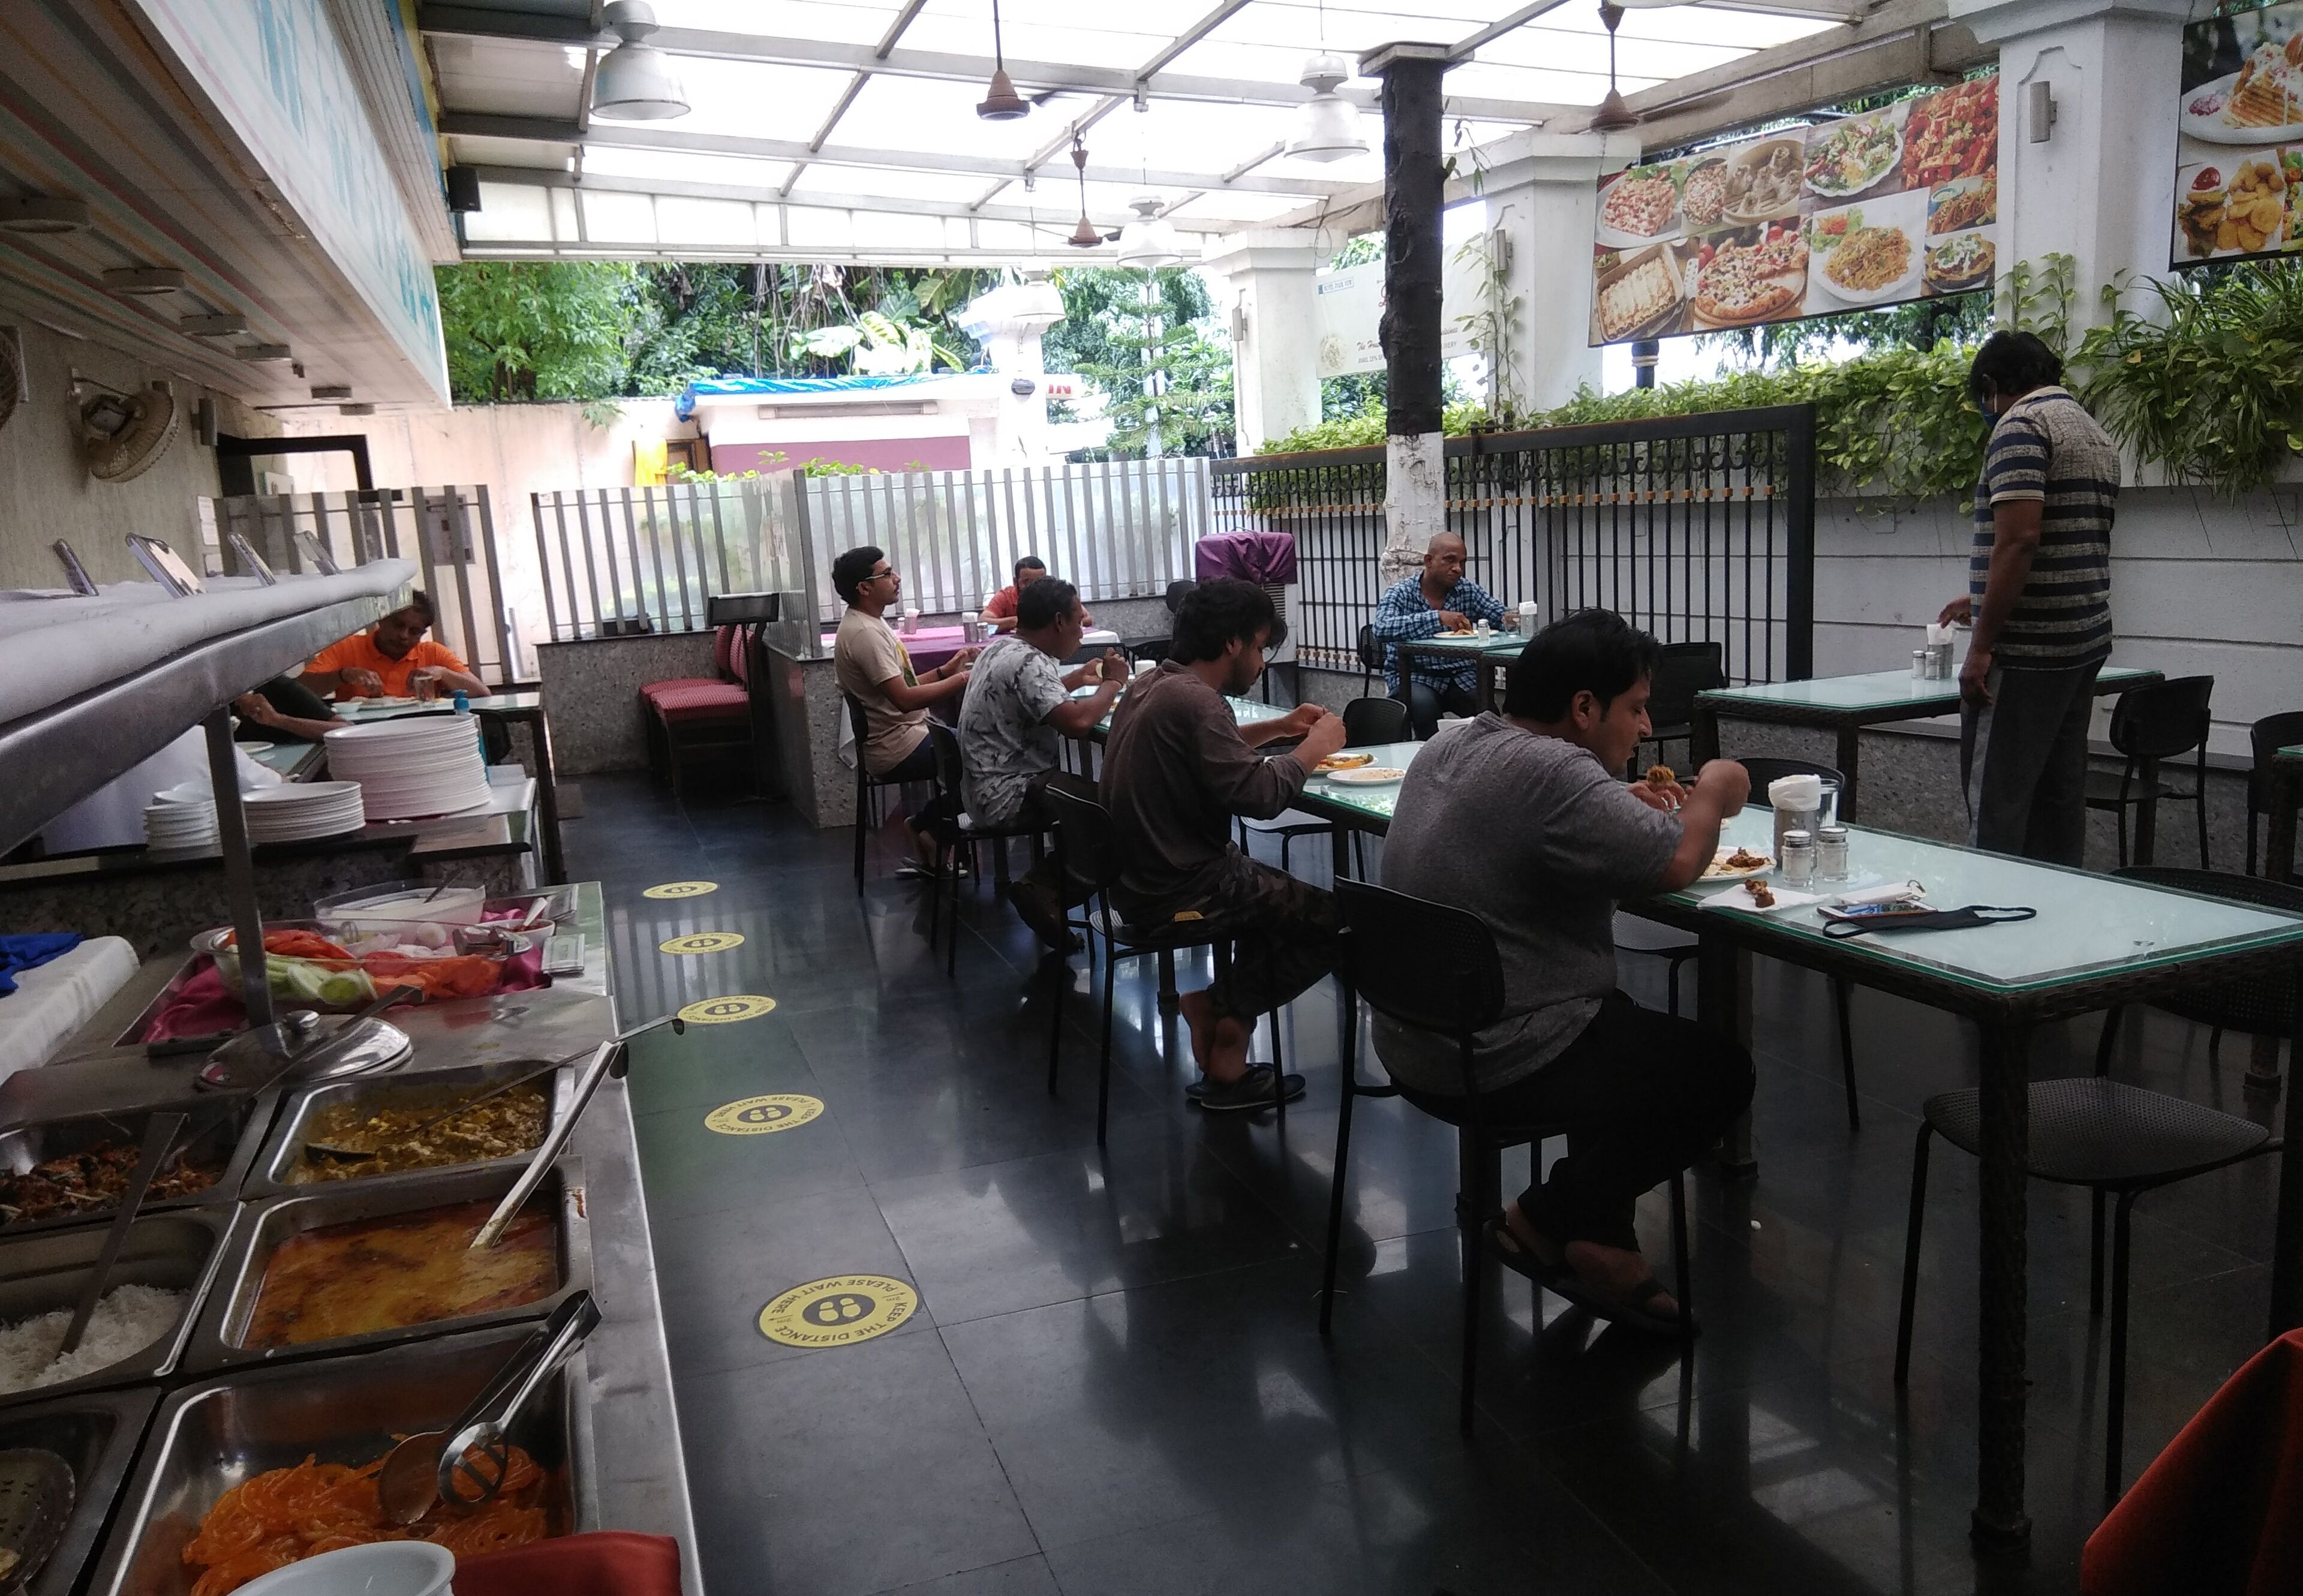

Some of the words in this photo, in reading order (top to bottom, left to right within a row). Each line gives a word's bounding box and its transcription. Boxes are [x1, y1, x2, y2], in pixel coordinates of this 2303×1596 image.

[737, 1098, 768, 1107] WAIT
[778, 1119, 800, 1129] THE
[802, 1281, 842, 1296] WAIT
[847, 1279, 898, 1292] PLEASE
[771, 1294, 801, 1314] HERE
[886, 1302, 908, 1322] KEEP
[775, 1326, 849, 1342] DISTANCE
[855, 1323, 887, 1336] THE
